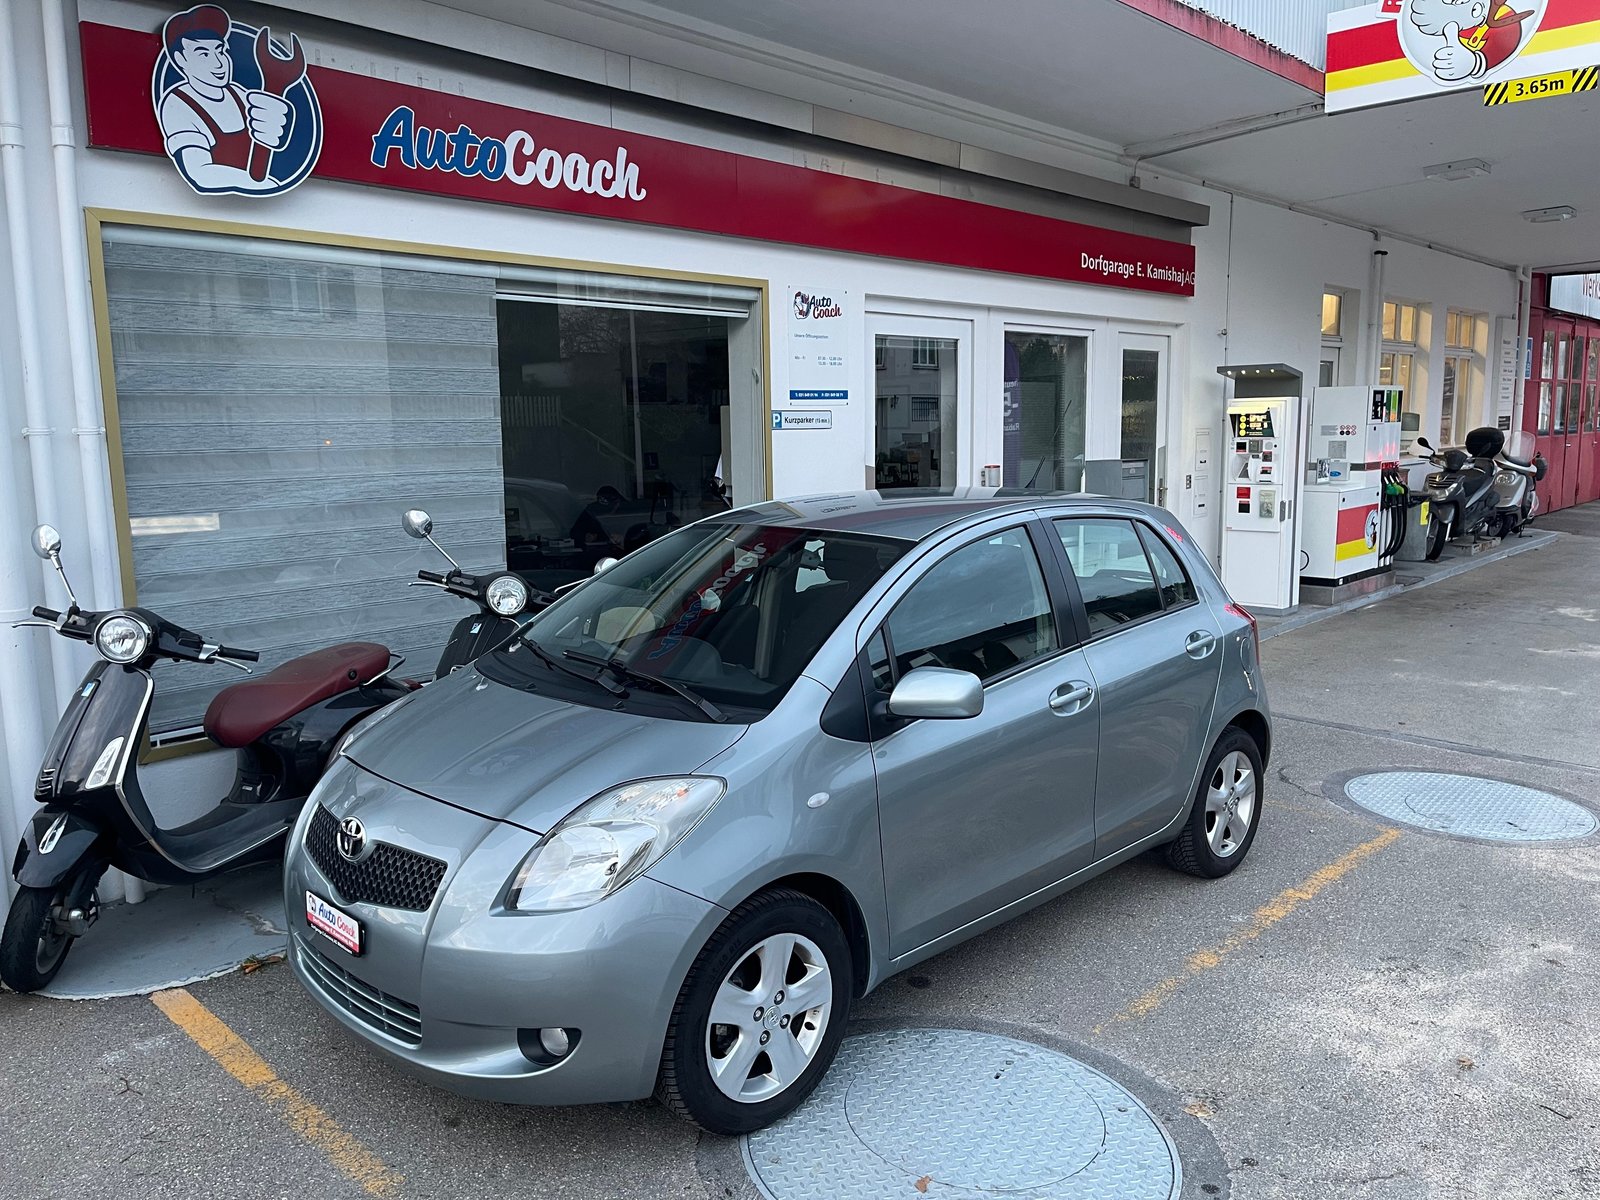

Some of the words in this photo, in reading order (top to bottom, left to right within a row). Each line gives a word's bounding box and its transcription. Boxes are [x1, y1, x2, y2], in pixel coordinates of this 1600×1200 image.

[1515, 77, 1564, 97] 3.65m
[1081, 252, 1134, 279] Dorfgarage
[1136, 262, 1145, 277] E.
[1147, 263, 1185, 287] Kamishaj
[1185, 270, 1196, 285] AG
[810, 295, 832, 309] Auto
[813, 303, 842, 319] Coach
[772, 413, 780, 428] P
[784, 416, 814, 425] Kurzparker
[318, 902, 336, 925] Auto
[337, 915, 355, 937] Coach
